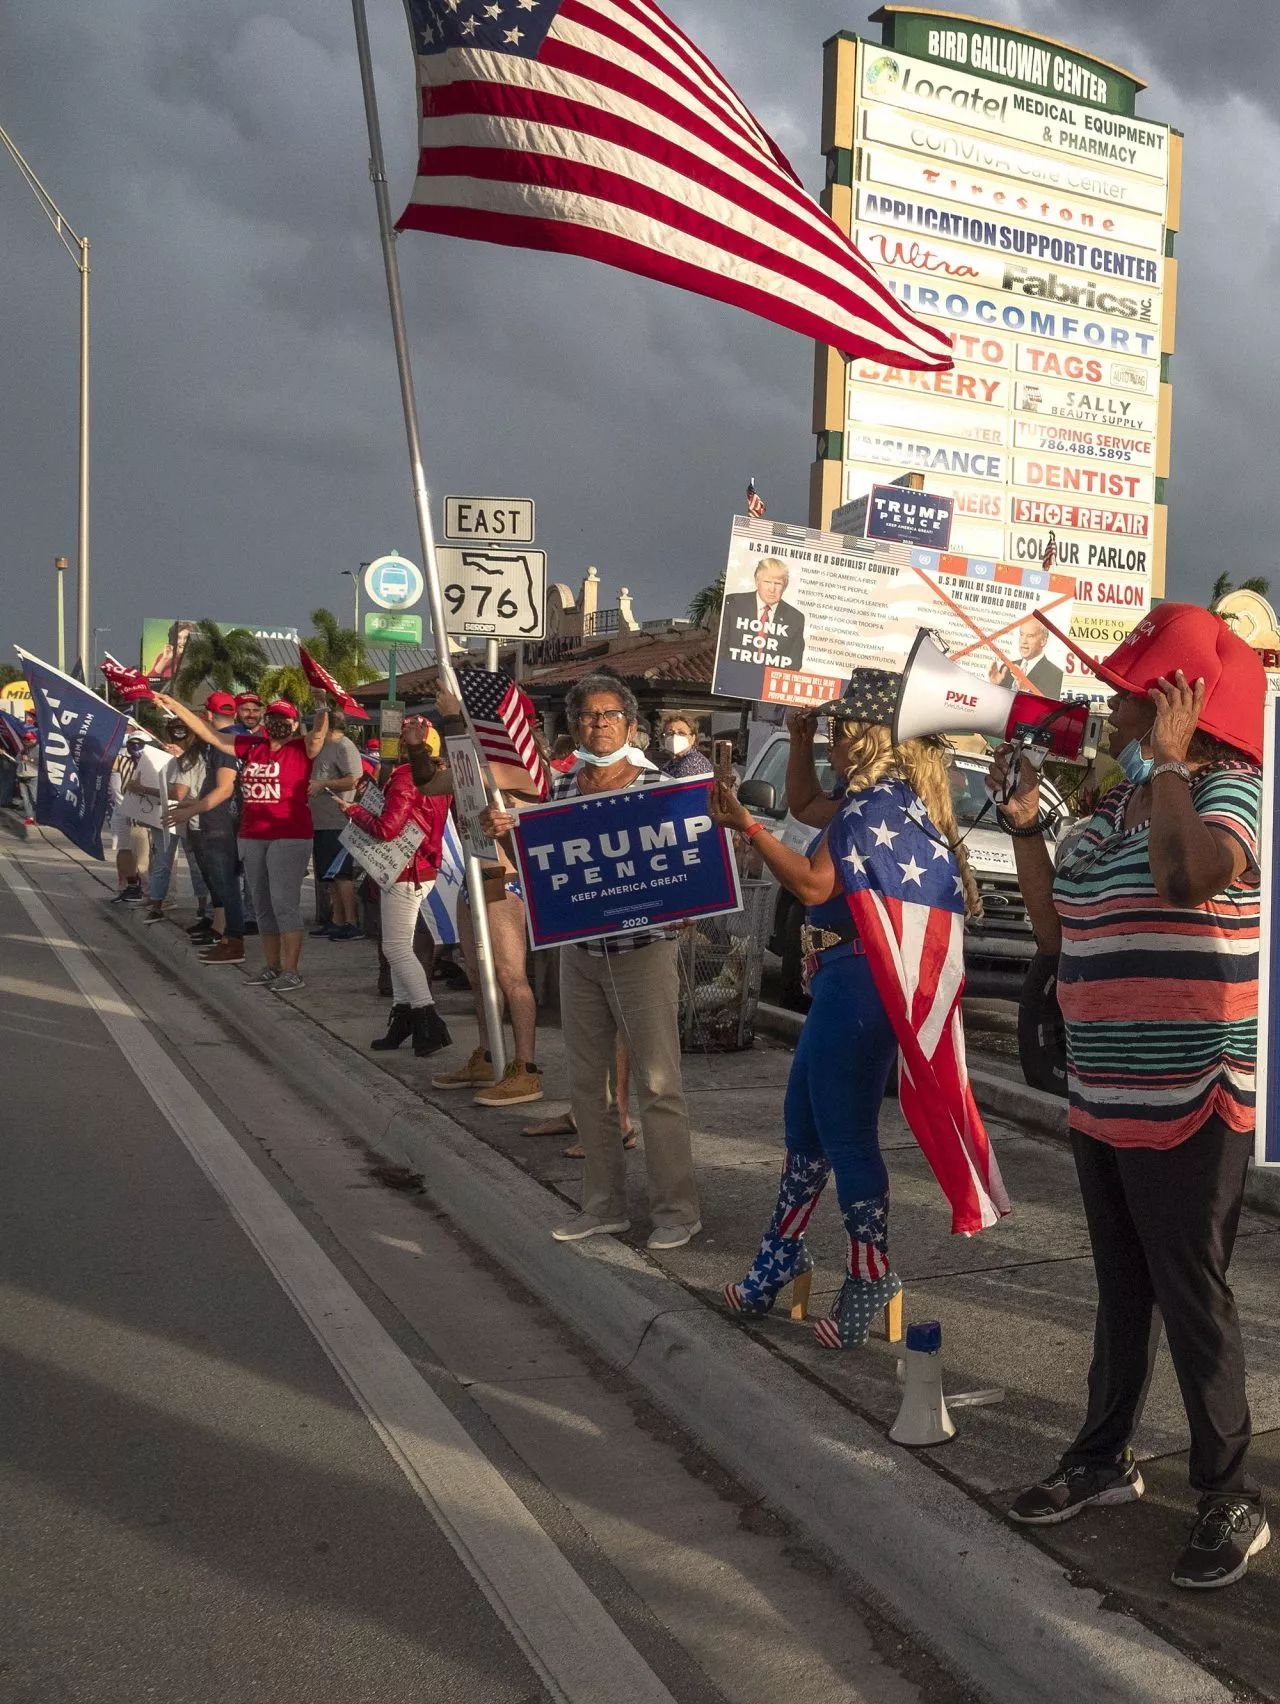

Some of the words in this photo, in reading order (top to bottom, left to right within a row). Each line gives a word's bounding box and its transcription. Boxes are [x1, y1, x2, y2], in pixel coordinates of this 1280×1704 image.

[928, 30, 968, 64] BIRD
[971, 33, 1051, 87] GALLOWAY
[1053, 56, 1107, 104] CENTER
[902, 68, 1008, 123] Locatel
[1013, 94, 1076, 126] MEDICAL
[1084, 114, 1164, 150] EQUIPMENT
[1042, 126, 1052, 143] &
[1059, 130, 1136, 165] PHARMACY
[865, 193, 997, 246] APPLICATION
[1000, 226, 1087, 267] SUPPORT
[1091, 247, 1157, 283] CENTER
[869, 234, 979, 277] Ultra
[1002, 262, 1138, 318] Fabrics
[1139, 297, 1152, 322] INC.
[888, 280, 1155, 355] UROCOMFORT
[1026, 348, 1103, 383] TAGS
[1066, 391, 1131, 416] SALLY
[1051, 406, 1098, 422] BEAUTY
[1102, 414, 1143, 429] SUPPLY
[1018, 421, 1093, 445] TUTORING
[1096, 433, 1152, 454] SERVICE
[1039, 438, 1132, 461] 786.488.5895
[1027, 461, 1140, 498] DENTIST
[458, 505, 520, 534] EAST
[875, 498, 949, 521] TRUMP
[880, 512, 941, 529] PENCE
[1020, 501, 1073, 527] SHOE
[1077, 509, 1145, 535] REPAIR
[771, 545, 788, 557] WILL
[790, 548, 812, 561] NEVER
[814, 555, 822, 563] BE
[831, 556, 867, 571] SOCIALIST
[868, 563, 900, 576] COUNTRY
[1016, 537, 1079, 565] COLUR
[1088, 545, 1147, 572] PARLOR
[800, 578, 818, 586] TRUMP
[801, 567, 820, 575] TRUMP
[444, 584, 518, 619] 976
[798, 589, 824, 598] PATRIOTS
[952, 590, 962, 600] THE
[965, 592, 979, 603] NEW
[981, 595, 1004, 607] WORLD
[1006, 601, 1027, 611] ORDER
[959, 579, 974, 590] WILL
[976, 582, 984, 592] BE
[986, 584, 1002, 595] SOLD
[1004, 587, 1012, 596] TO
[1014, 590, 1034, 600] CHINA
[1097, 582, 1144, 606] SALON
[797, 600, 816, 608] TRUMP
[736, 617, 789, 637] HONK
[858, 620, 879, 629] TROOPS
[742, 634, 779, 652] FOR
[729, 648, 793, 669] TRUMP
[807, 657, 835, 666] AMERICAN
[836, 661, 855, 669] VALUES
[7, 689, 31, 699] MID
[946, 690, 978, 707] PYLE
[527, 815, 713, 871] TRUMP
[551, 848, 701, 891] PENCE
[571, 891, 598, 903] KEEP
[600, 881, 648, 897] AMERICA
[650, 874, 688, 888] GREAT!
[622, 916, 649, 928] 2020
